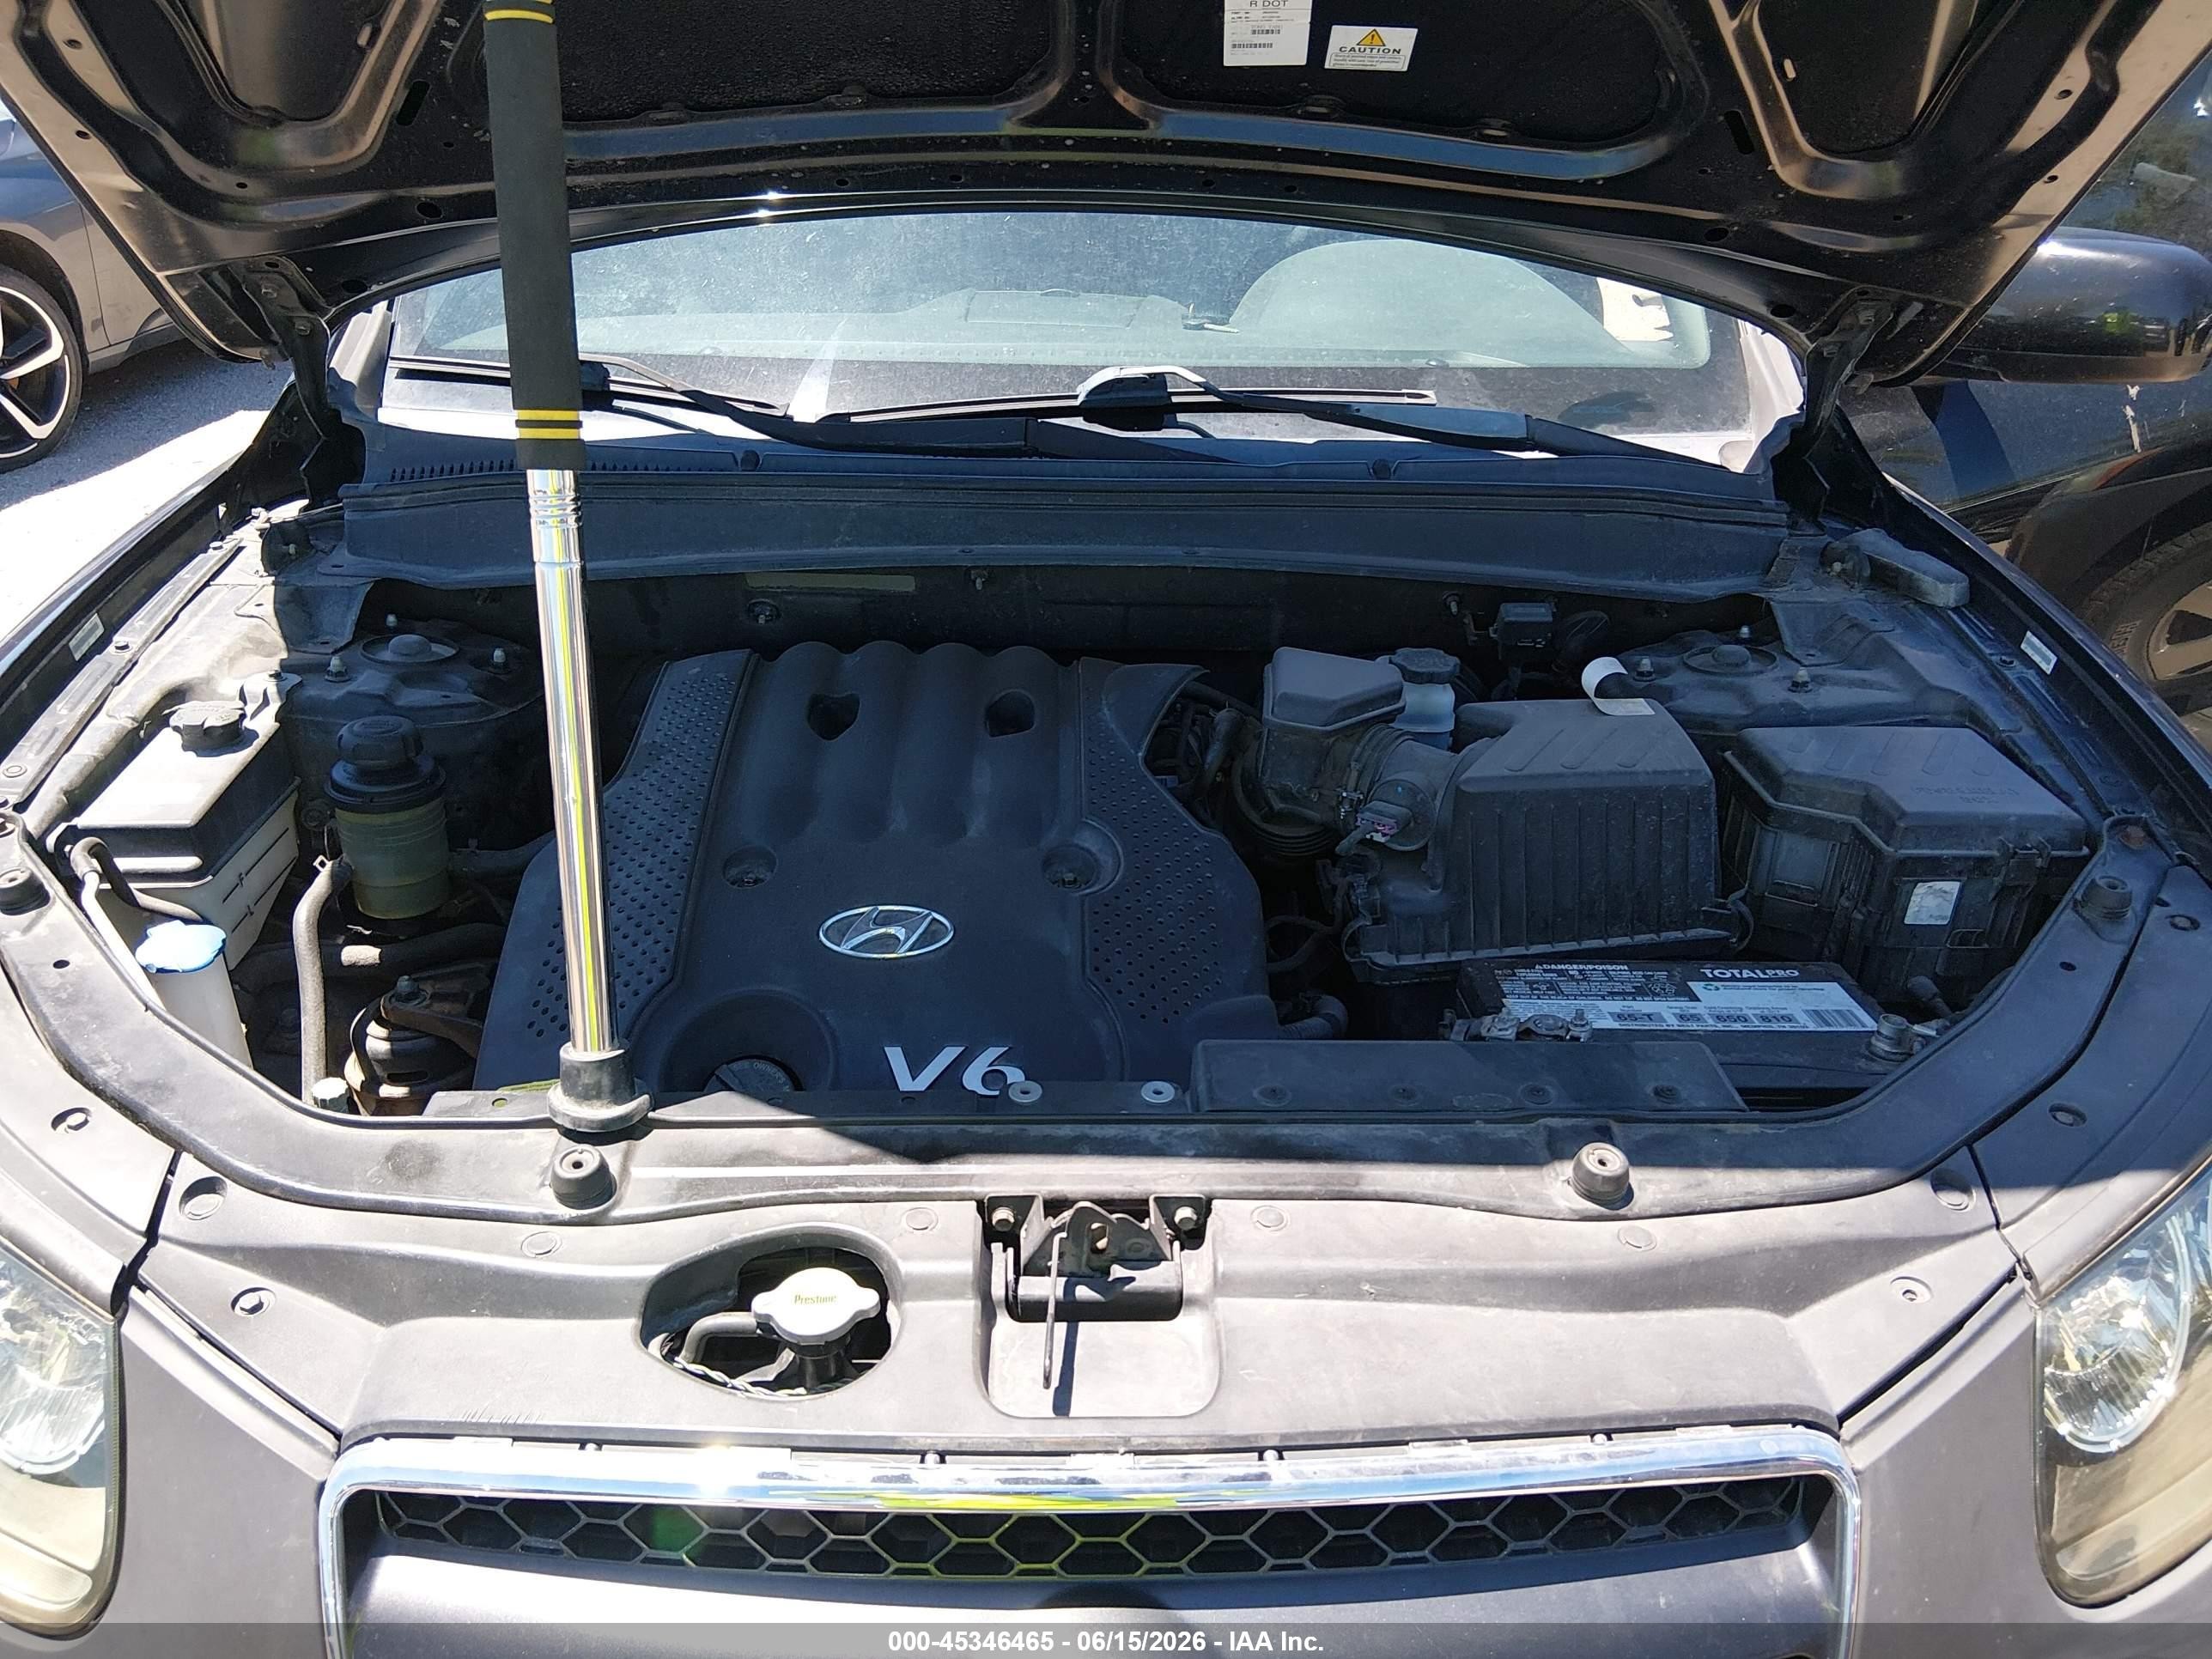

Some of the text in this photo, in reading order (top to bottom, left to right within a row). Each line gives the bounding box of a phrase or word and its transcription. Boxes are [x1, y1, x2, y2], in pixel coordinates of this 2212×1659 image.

[238, 872, 245, 887] F
[247, 904, 254, 916] L
[1699, 969, 1800, 979] TOTALPRO
[1616, 1013, 1654, 1022] 65-T
[1679, 1013, 1701, 1022] 65
[884, 1046, 1025, 1096] V6
